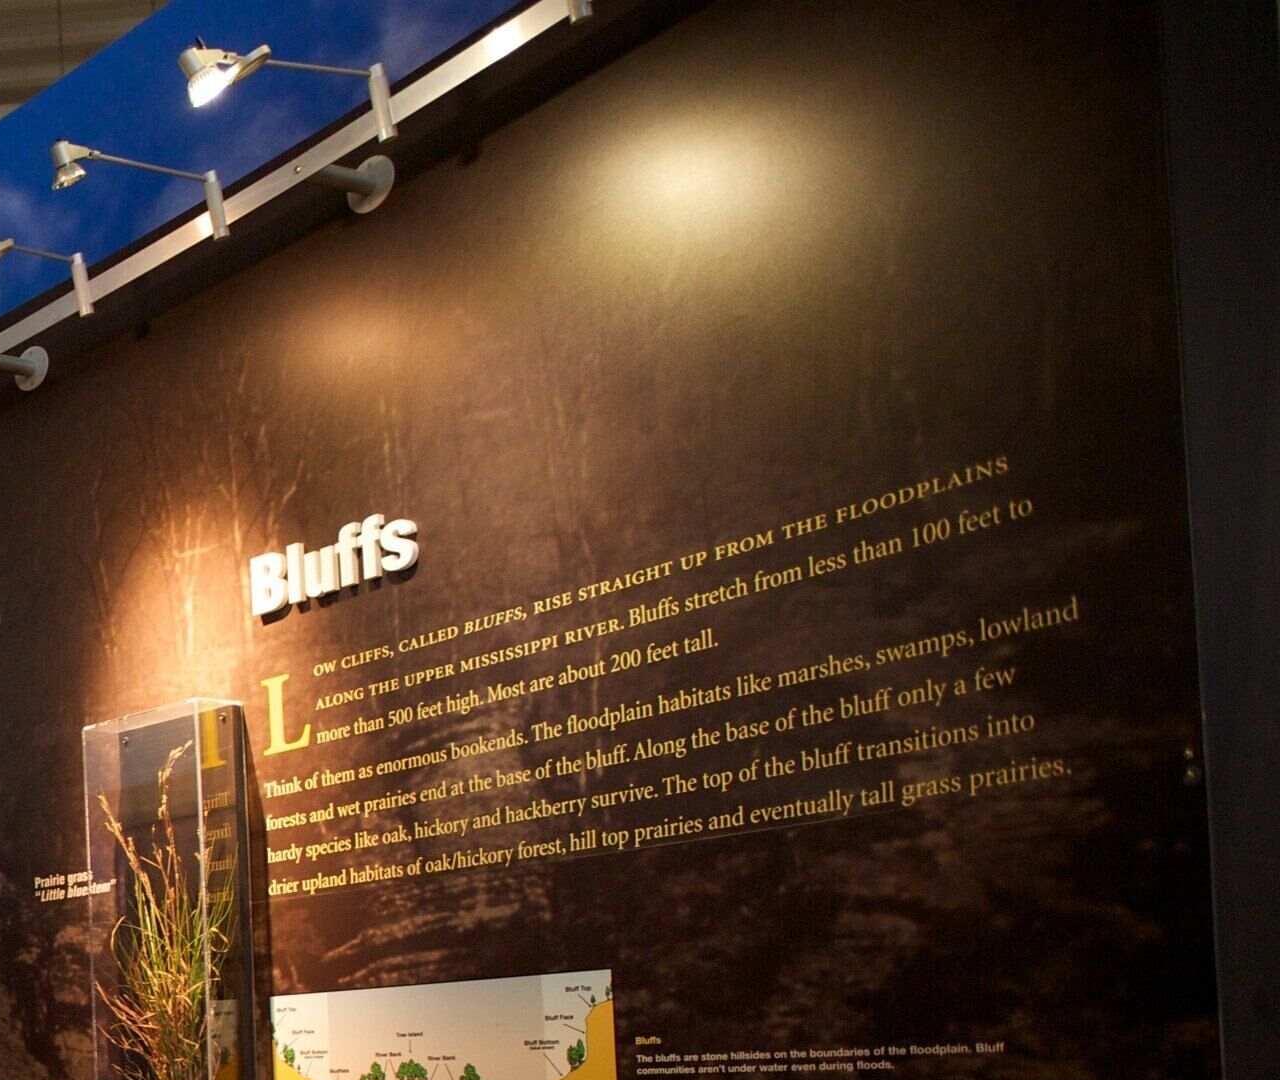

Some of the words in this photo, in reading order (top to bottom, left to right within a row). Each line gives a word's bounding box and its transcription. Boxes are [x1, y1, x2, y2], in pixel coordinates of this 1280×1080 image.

[250, 513, 418, 616] Bluffs
[314, 686, 364, 711] ALONG
[367, 677, 400, 696] THE
[403, 663, 455, 687] UPPER
[459, 634, 558, 673] MISSISSIPPI
[564, 618, 625, 645] RIVER.
[628, 595, 679, 628] Bluffs
[684, 576, 748, 612] stretch
[753, 566, 802, 592] from
[807, 553, 847, 577] less
[852, 537, 902, 564] than
[911, 518, 950, 547] 100
[958, 505, 1000, 534] feet
[1008, 499, 1033, 520] to
[340, 644, 394, 669] CLIFFS,
[398, 625, 459, 653] CALLED
[463, 605, 527, 635] BLUFFS,
[532, 591, 572, 615] RISE
[577, 560, 673, 601] STRAIGHT
[679, 550, 707, 570] UP
[714, 529, 774, 561] FROM
[781, 513, 827, 539] THE
[835, 456, 1008, 524] FLOODPLAINS
[263, 775, 303, 799] Think
[303, 770, 319, 790] of
[320, 768, 355, 787] them
[357, 764, 373, 779] as
[375, 748, 447, 775] enormous
[449, 725, 528, 759] bookends.
[530, 720, 562, 742] The
[566, 700, 653, 735] floodplain
[657, 685, 731, 714] habitats
[735, 672, 772, 697] like
[777, 654, 871, 688] marshes,
[875, 630, 974, 665] swamps,
[979, 597, 1079, 641] lowland
[316, 724, 351, 744] more
[353, 716, 384, 735] than
[387, 706, 413, 727] 500
[416, 700, 443, 720] feet
[445, 688, 484, 715] high.
[486, 679, 526, 704] Most
[529, 674, 554, 693] are
[558, 659, 606, 686] about
[609, 648, 641, 673] 200
[646, 640, 679, 664] feet
[683, 627, 718, 654] tall.
[265, 811, 307, 831] forests
[308, 802, 335, 823] and
[336, 800, 361, 818] wet
[363, 789, 416, 818] prairies
[419, 779, 447, 802] end
[450, 780, 465, 797] at
[467, 773, 492, 793] the
[495, 769, 531, 788] base
[534, 758, 553, 780] of
[555, 755, 584, 776] the
[585, 742, 630, 770] bluff.
[632, 737, 687, 761] Along
[690, 727, 720, 749] the
[724, 720, 769, 742] base
[774, 707, 797, 732] of
[800, 703, 834, 727] the
[839, 686, 893, 719] bluff
[897, 678, 946, 707] only
[953, 679, 966, 696] a
[974, 666, 1015, 691] few
[266, 842, 303, 864] hardy
[305, 835, 352, 861] species
[353, 830, 379, 849] like
[381, 824, 412, 844] oak,
[413, 817, 469, 839] hickory
[472, 806, 501, 829] and
[504, 797, 587, 824] hackberry
[590, 782, 658, 809] survive.
[661, 773, 697, 796] The
[702, 770, 733, 792] top
[738, 758, 760, 782] of
[763, 755, 796, 778] the
[800, 741, 852, 771] bluff
[856, 724, 979, 761] transitions
[986, 714, 1035, 738] into
[34, 874, 65, 889] Prairie
[67, 870, 93, 887] grass
[267, 877, 300, 896] drier
[301, 868, 347, 895] upland
[348, 863, 404, 884] habitats
[406, 856, 423, 876] of
[424, 847, 514, 873] oak/hickory
[517, 838, 566, 859] forest,
[569, 828, 597, 852] hill
[601, 830, 629, 850] top
[633, 815, 703, 848] prairies
[708, 804, 744, 830] and
[749, 788, 854, 824] eventually
[860, 779, 895, 806] tall
[901, 776, 961, 807] grass
[968, 756, 1072, 796] prairies.
[580, 985, 592, 993] Top
[635, 1035, 662, 1045] Bluffs
[635, 1054, 653, 1062] The
[655, 1053, 681, 1062] bluffs
[701, 1052, 728, 1061] stone
[730, 1050, 771, 1060] hillsides
[773, 1051, 787, 1059] on
[789, 1049, 807, 1058] the
[809, 1047, 870, 1058] boundaries
[873, 1046, 885, 1056] of
[887, 1045, 906, 1055] the
[909, 1043, 971, 1056] floodplain.
[975, 1043, 1004, 1052] Bluff
[636, 1065, 695, 1074] communities
[697, 1064, 725, 1073] aren't
[727, 1063, 756, 1072] under
[758, 1063, 788, 1071] water
[790, 1063, 816, 1071] even
[818, 1061, 853, 1072] during
[856, 1059, 894, 1069] floods.
